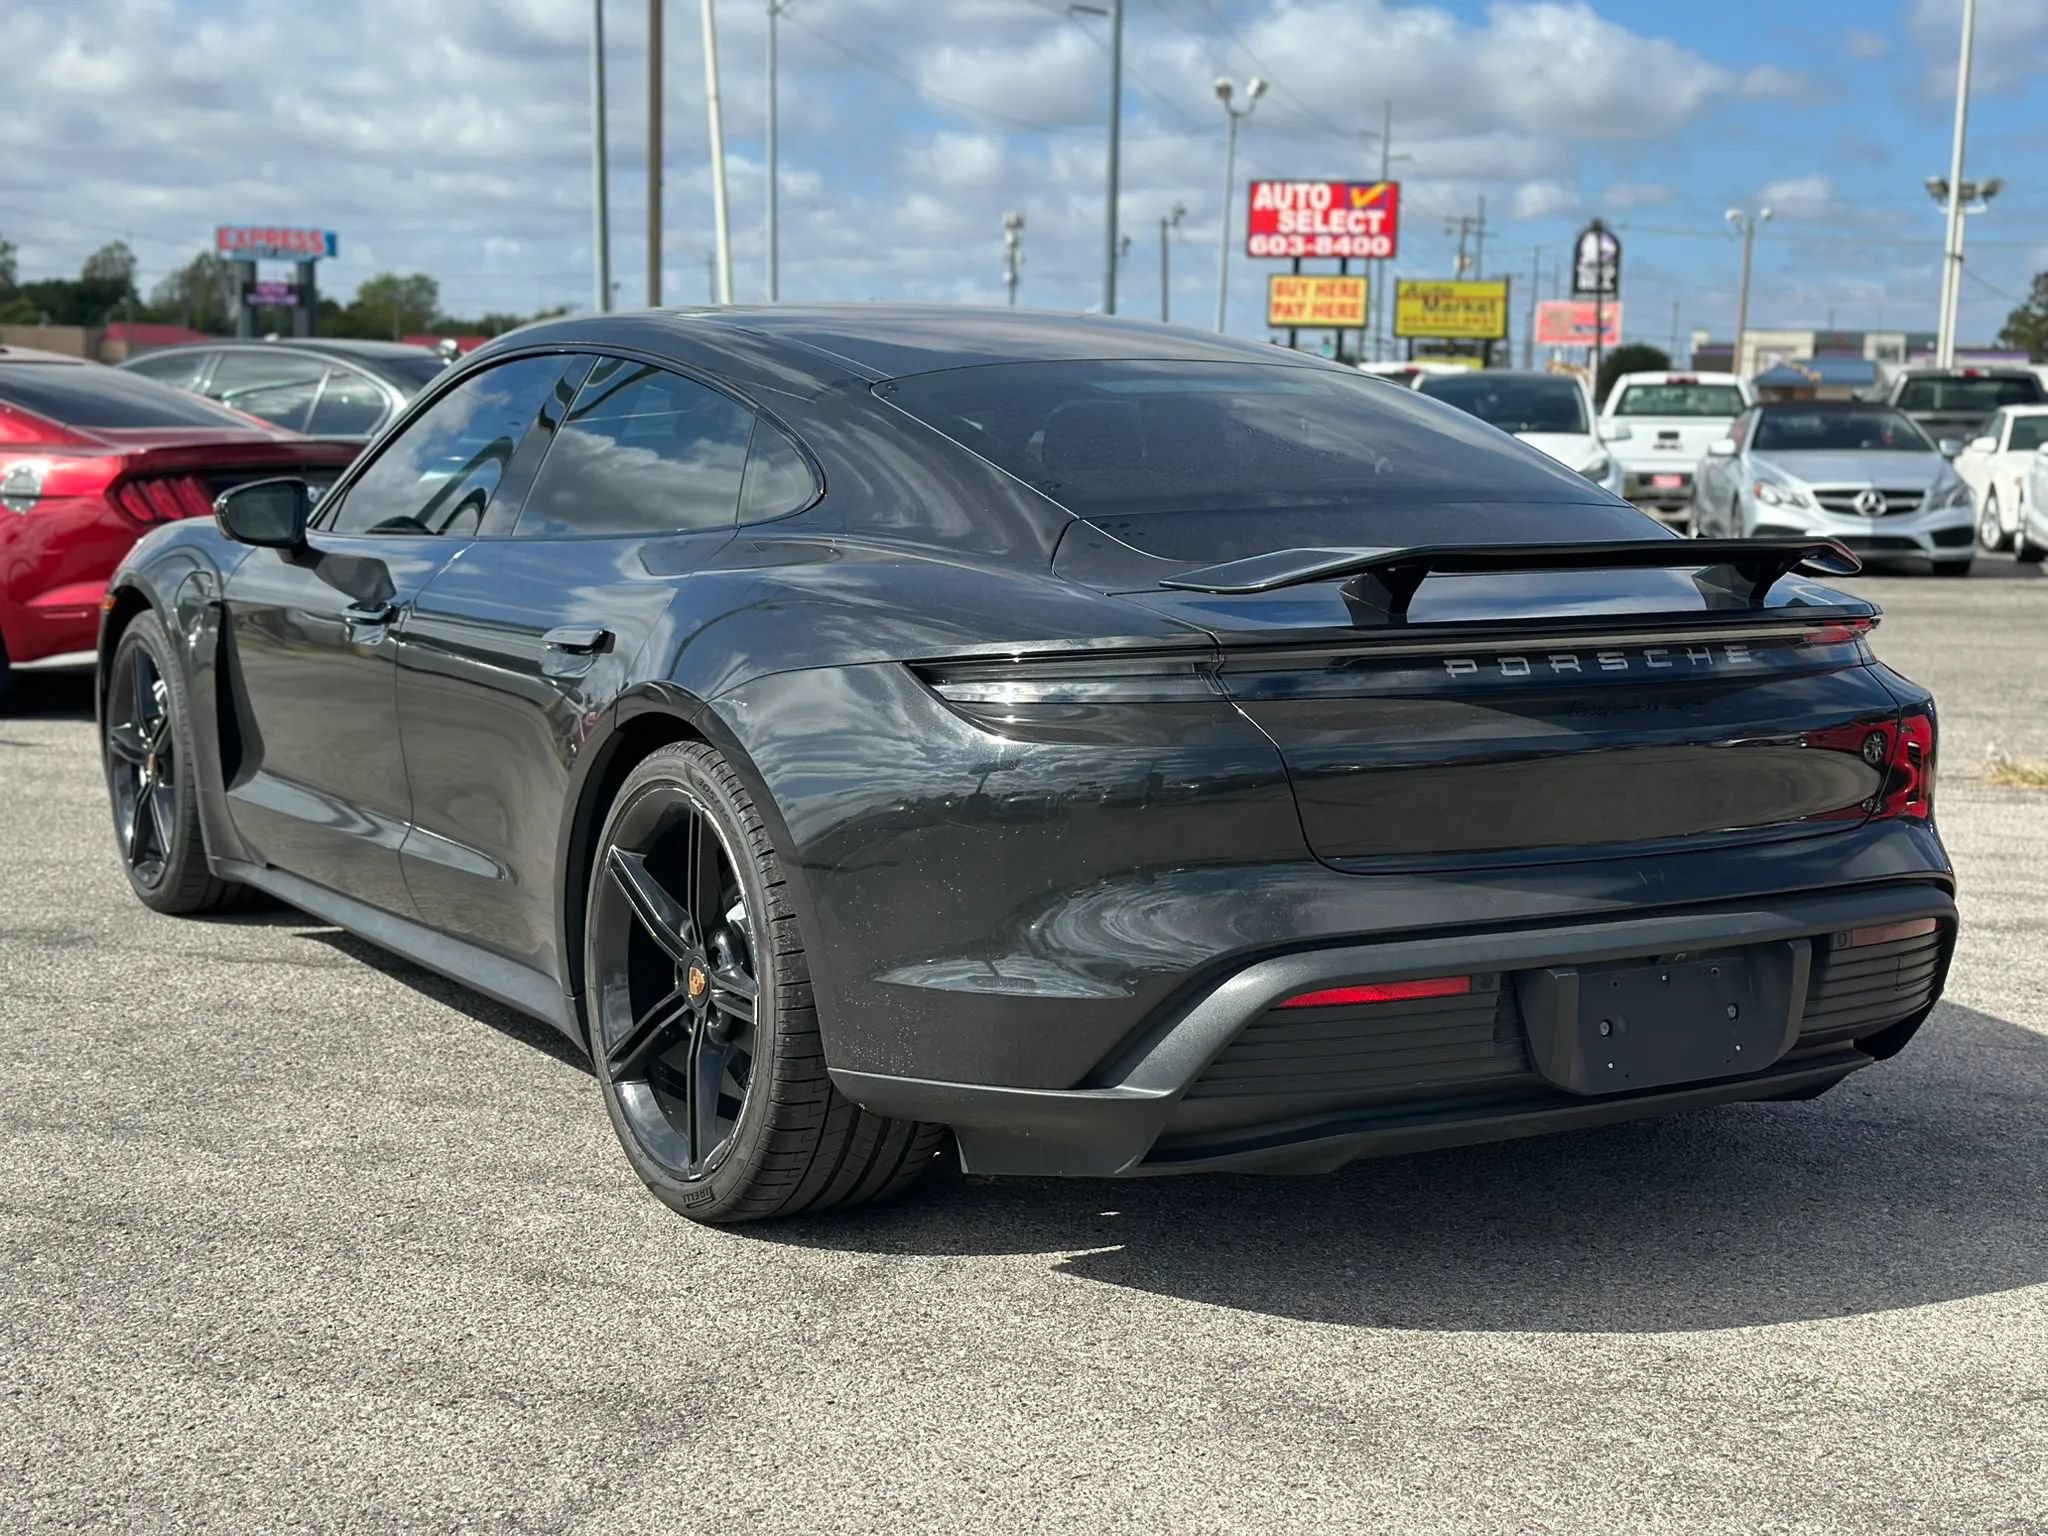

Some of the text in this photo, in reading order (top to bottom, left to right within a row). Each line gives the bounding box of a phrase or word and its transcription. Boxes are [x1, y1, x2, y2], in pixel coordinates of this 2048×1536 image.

[1253, 183, 1332, 211] AUTO
[1277, 208, 1387, 234] SELECT
[217, 227, 325, 254] EXPRESS
[1249, 234, 1391, 256] 603-8400
[1274, 281, 1361, 298] BUY HERE
[1271, 302, 1360, 320] PAY HERE
[1443, 645, 1751, 678] PORSCHE
[682, 1185, 716, 1209] PIRELLI
